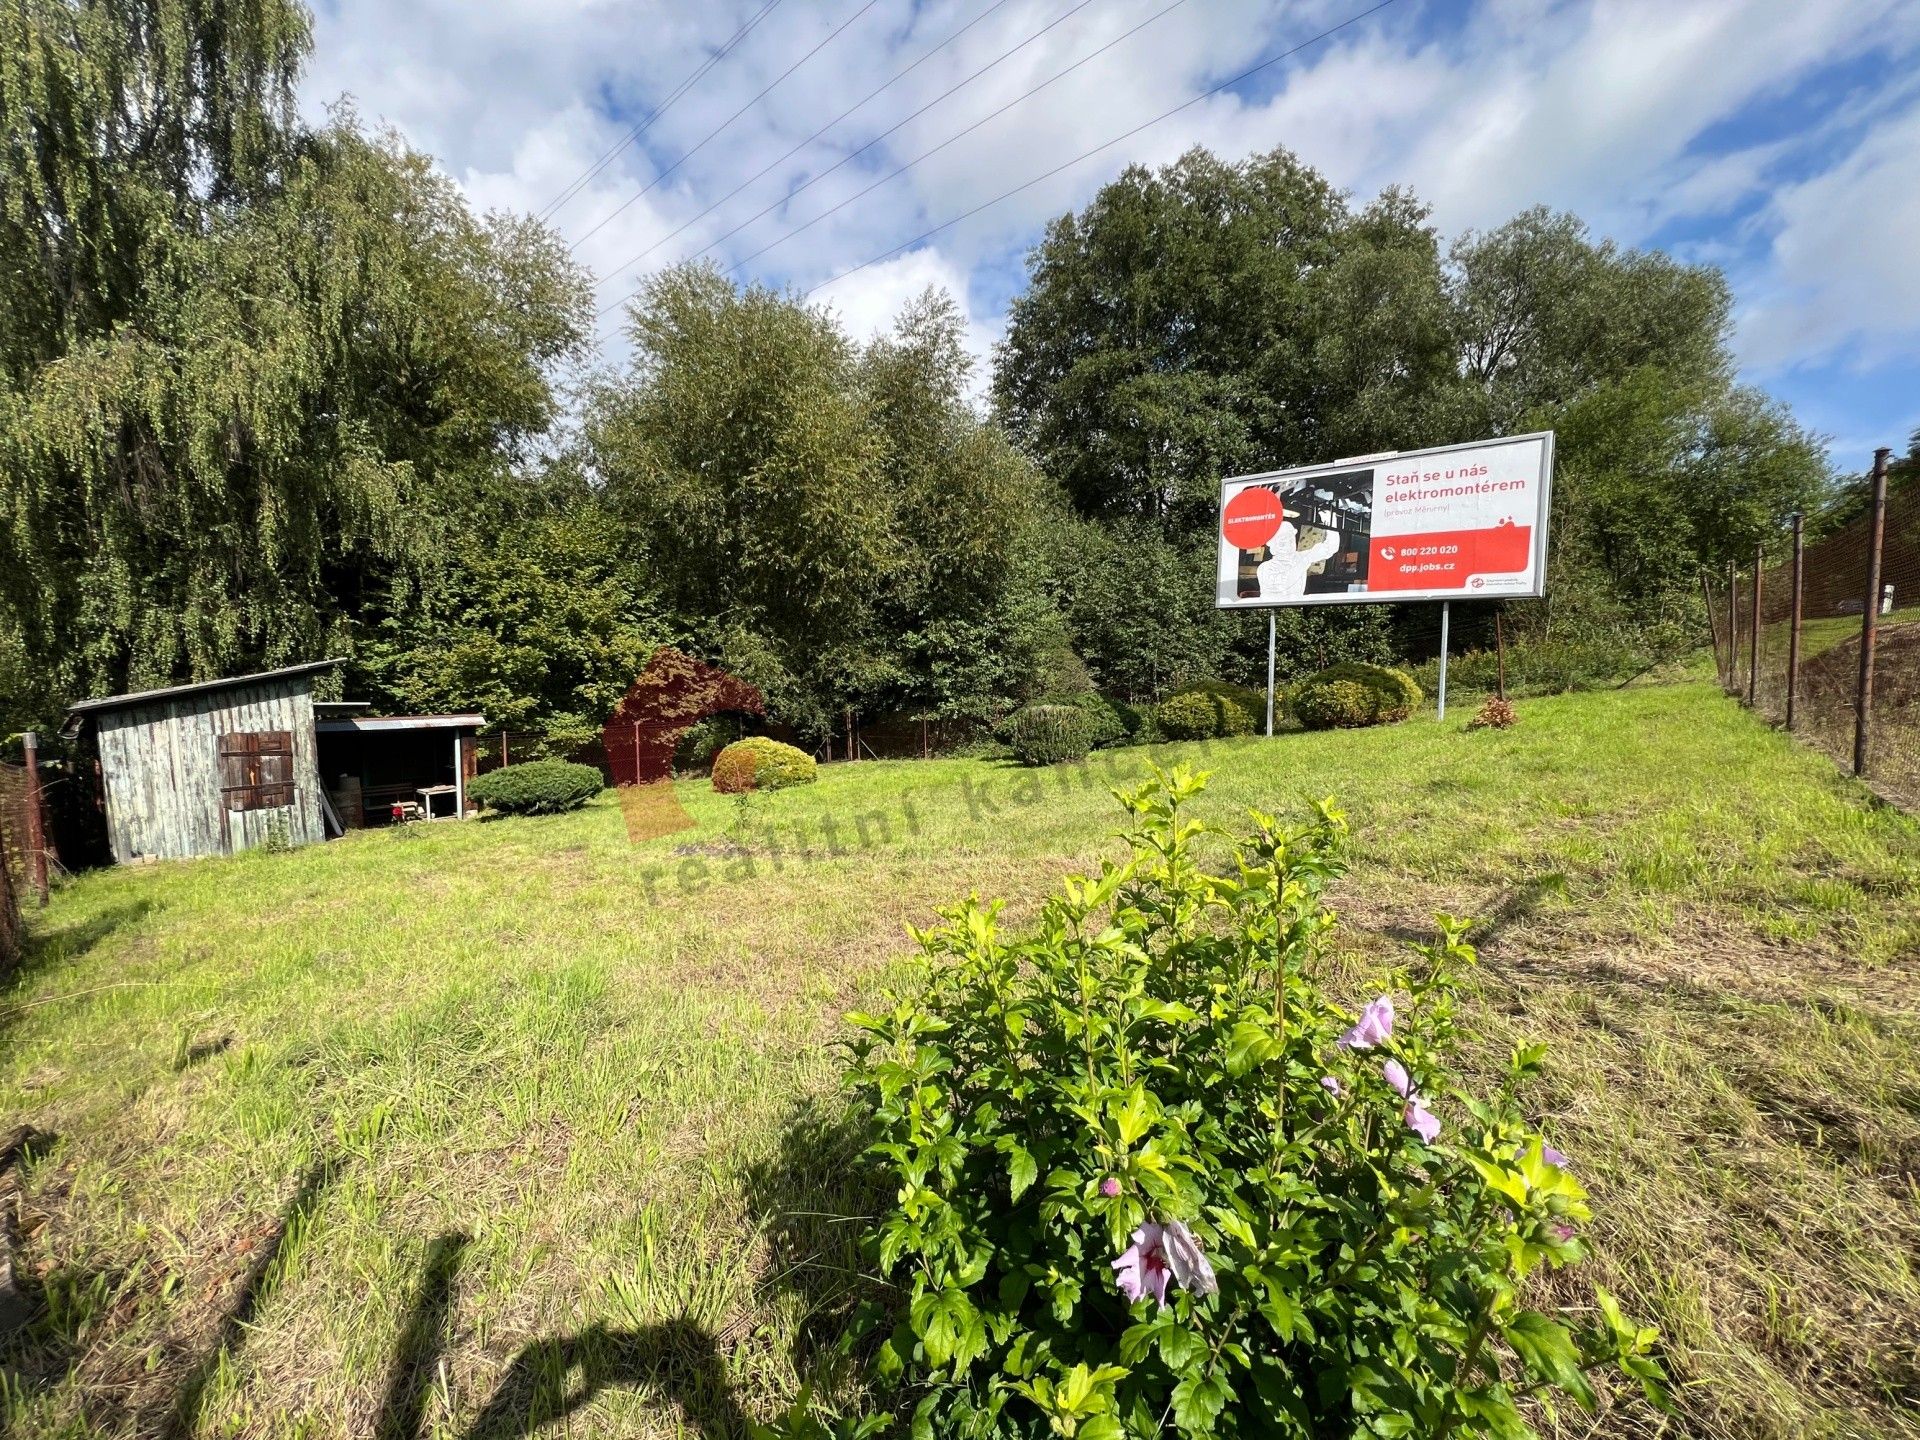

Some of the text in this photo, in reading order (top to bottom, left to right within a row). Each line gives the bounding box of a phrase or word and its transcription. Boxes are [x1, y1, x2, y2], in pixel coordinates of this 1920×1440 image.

[1386, 463, 1488, 486] Staň se u nás
[1385, 479, 1526, 503] elektromontérem
[1400, 545, 1458, 557] 800 220 020
[1399, 562, 1456, 573] dpp.jobs.cz
